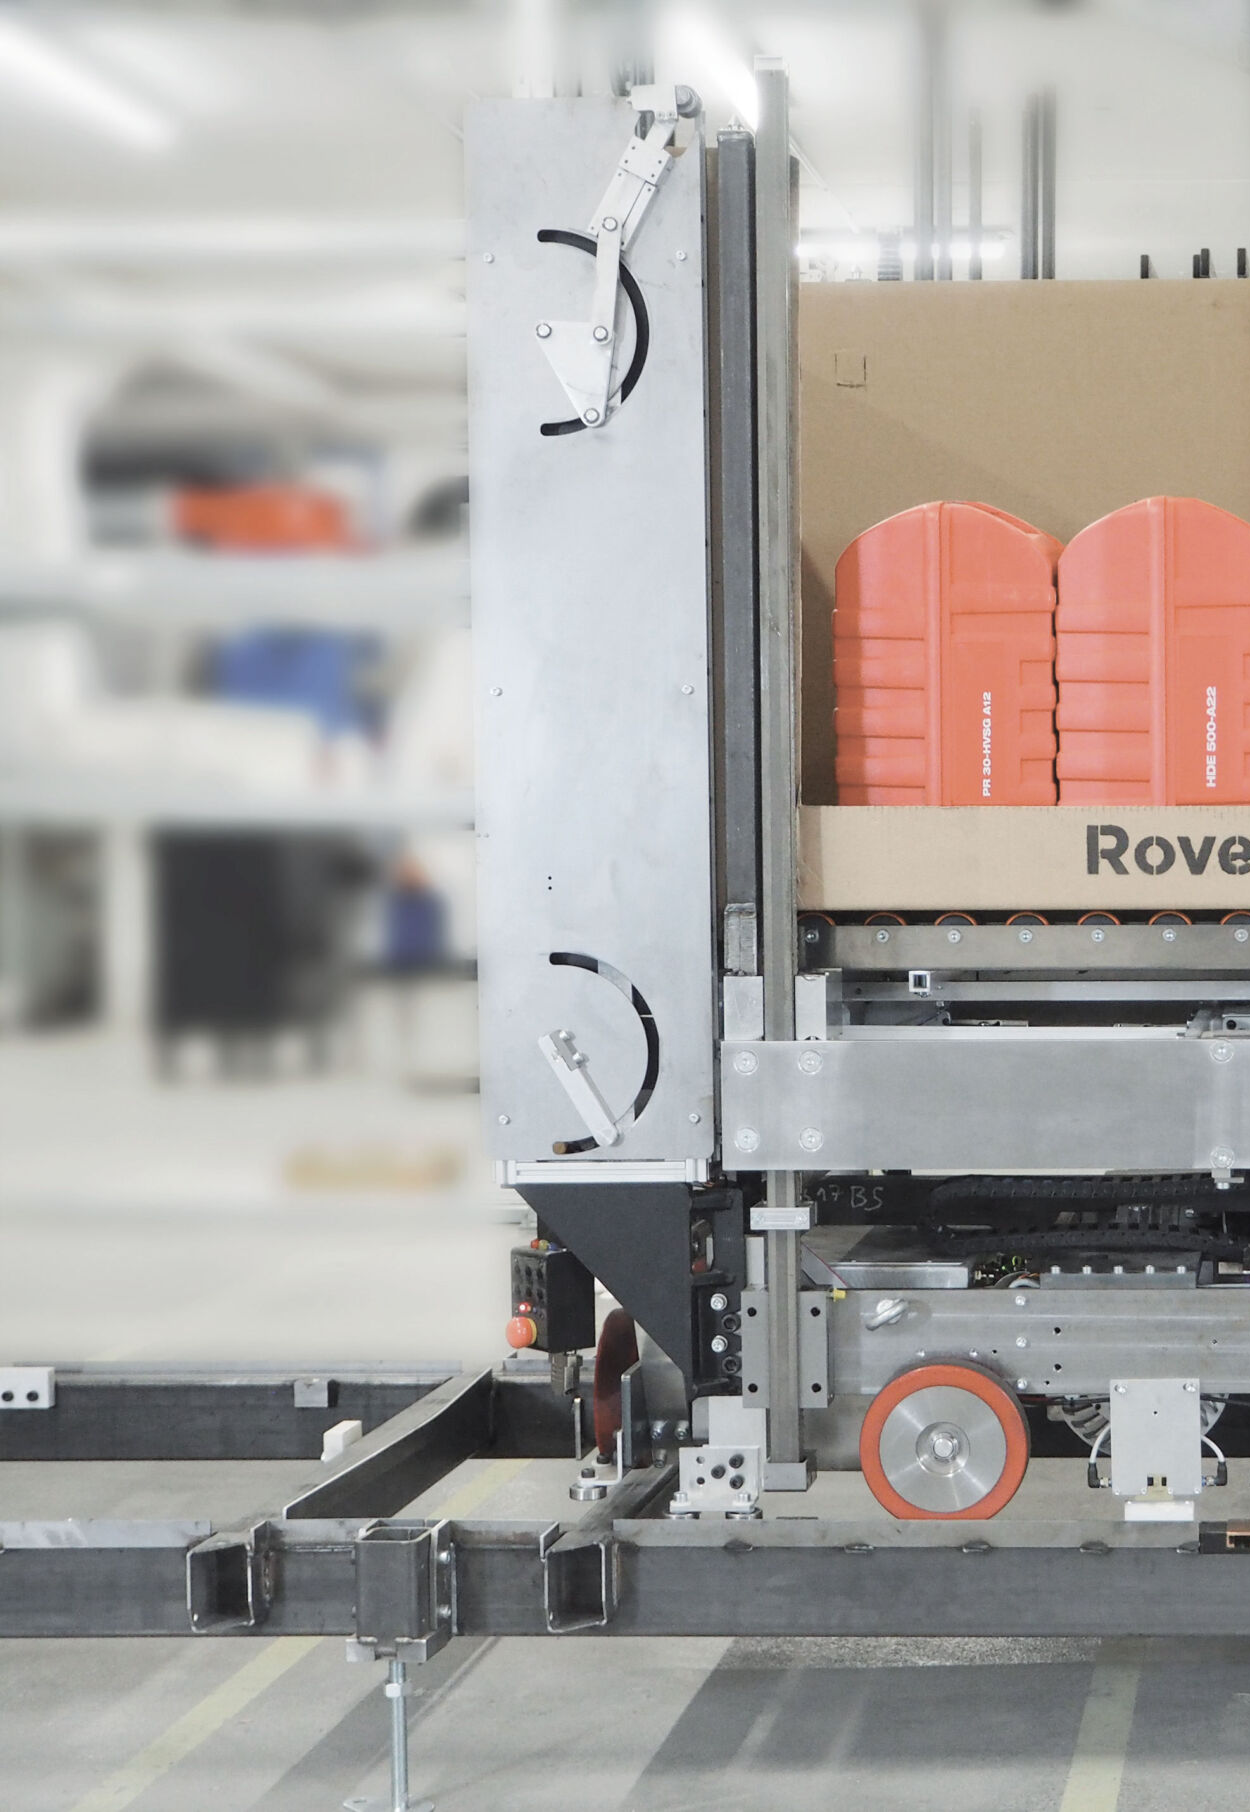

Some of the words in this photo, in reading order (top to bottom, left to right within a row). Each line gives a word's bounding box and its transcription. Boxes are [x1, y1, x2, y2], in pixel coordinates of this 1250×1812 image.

[983, 692, 992, 715] A12
[1206, 686, 1216, 752] 500-A22
[983, 719, 992, 775] 30-HVSG
[1206, 755, 1216, 787] HDE
[983, 779, 992, 797] PR
